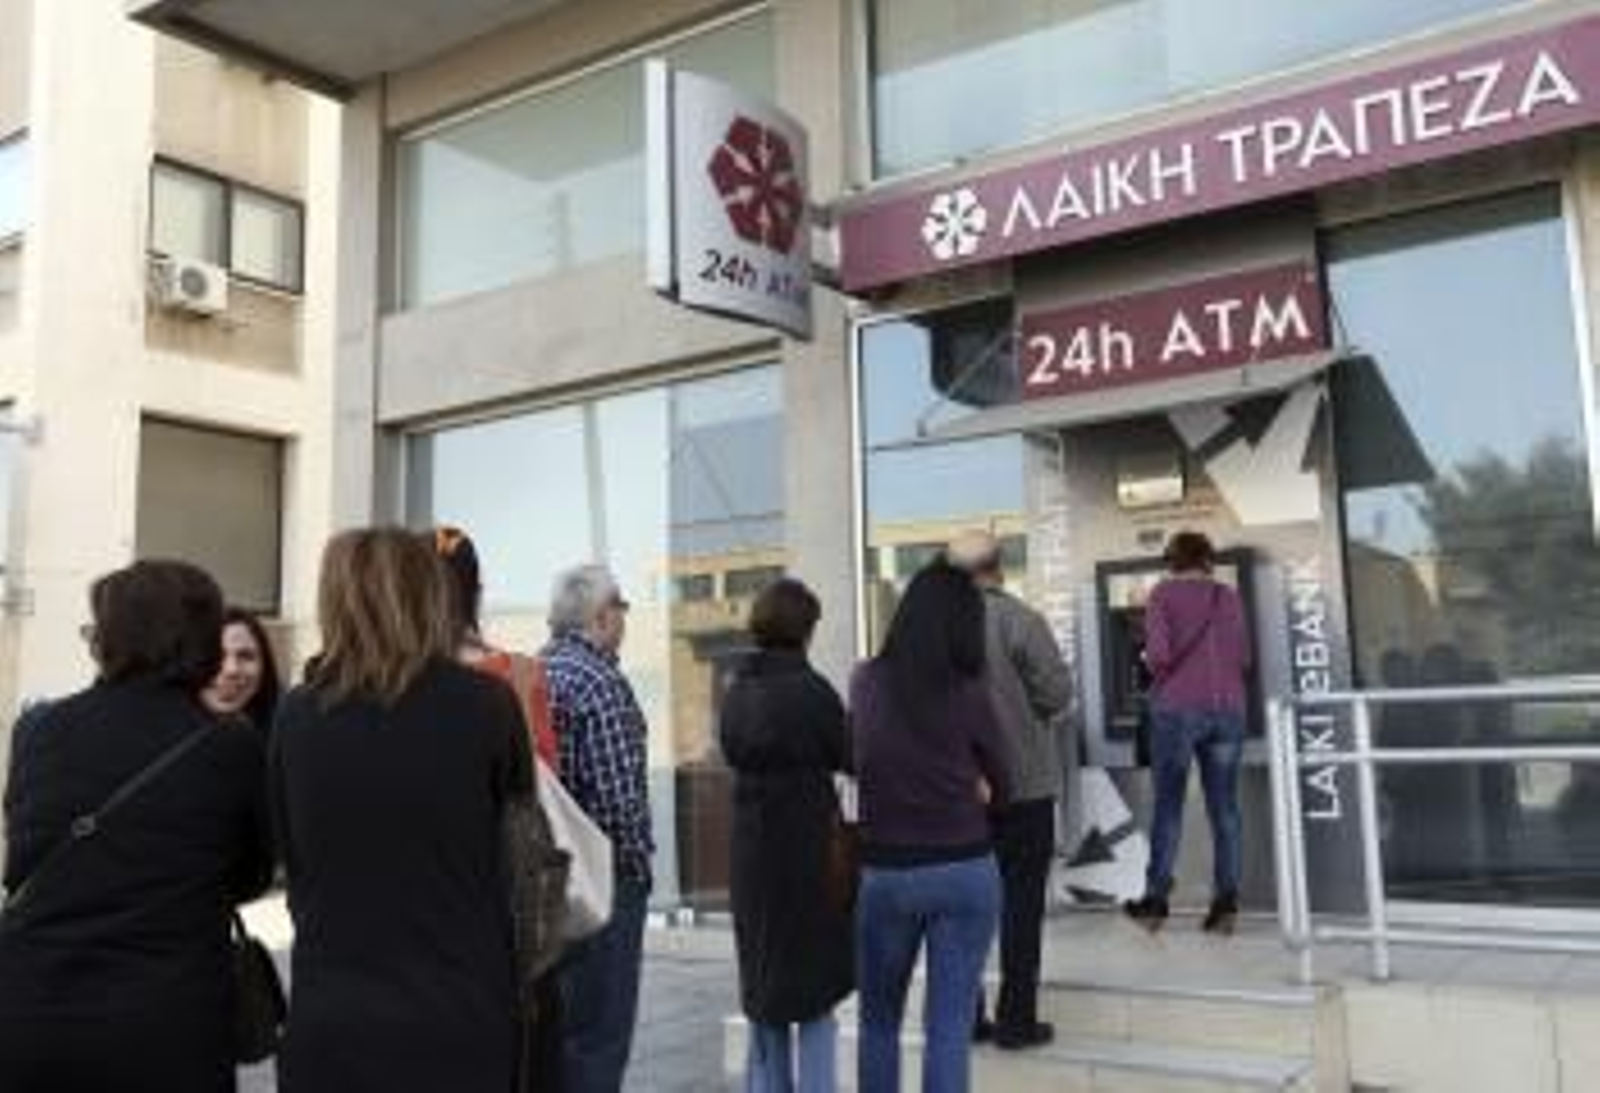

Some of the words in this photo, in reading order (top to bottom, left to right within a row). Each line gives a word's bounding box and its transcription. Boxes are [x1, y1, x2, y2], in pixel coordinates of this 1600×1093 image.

[1003, 144, 1196, 237] ΛΑΙΚΗ
[1217, 52, 1579, 183] ΤΡΑΠΕΖΑ
[698, 248, 757, 290] 24h
[1026, 322, 1134, 385] 24h
[1160, 293, 1312, 363] ATM
[1301, 713, 1340, 820] LAKI
